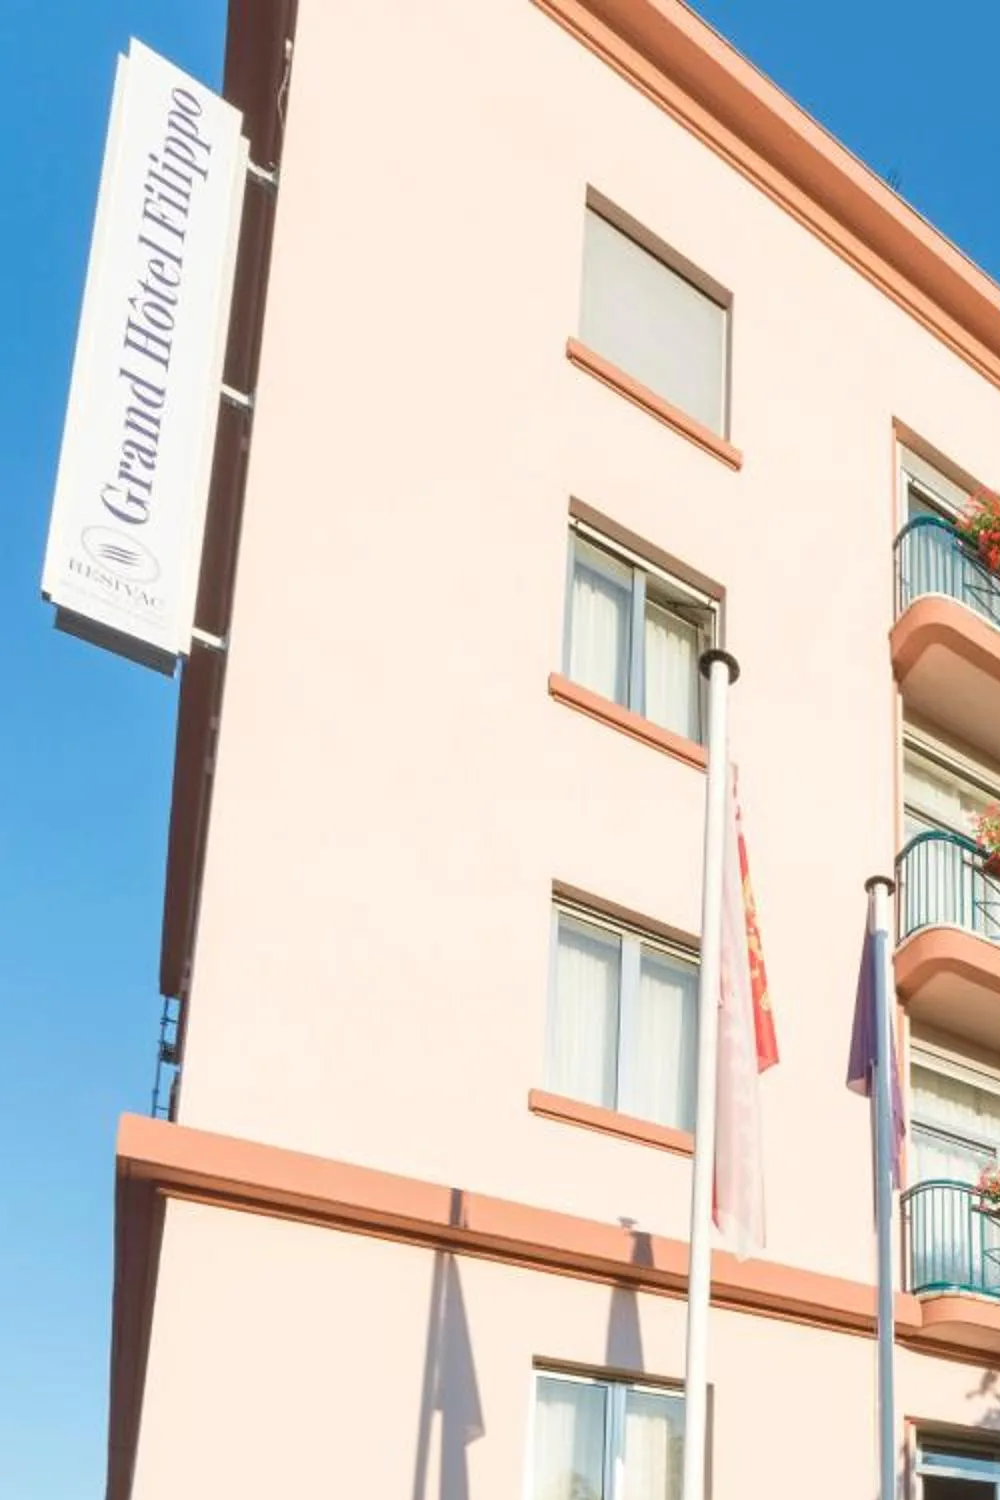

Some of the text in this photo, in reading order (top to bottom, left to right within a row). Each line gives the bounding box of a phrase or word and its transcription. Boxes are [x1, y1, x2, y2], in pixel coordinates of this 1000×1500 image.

[142, 86, 211, 245] Filippo
[123, 233, 184, 373] Hôtel
[99, 366, 166, 526] Grand
